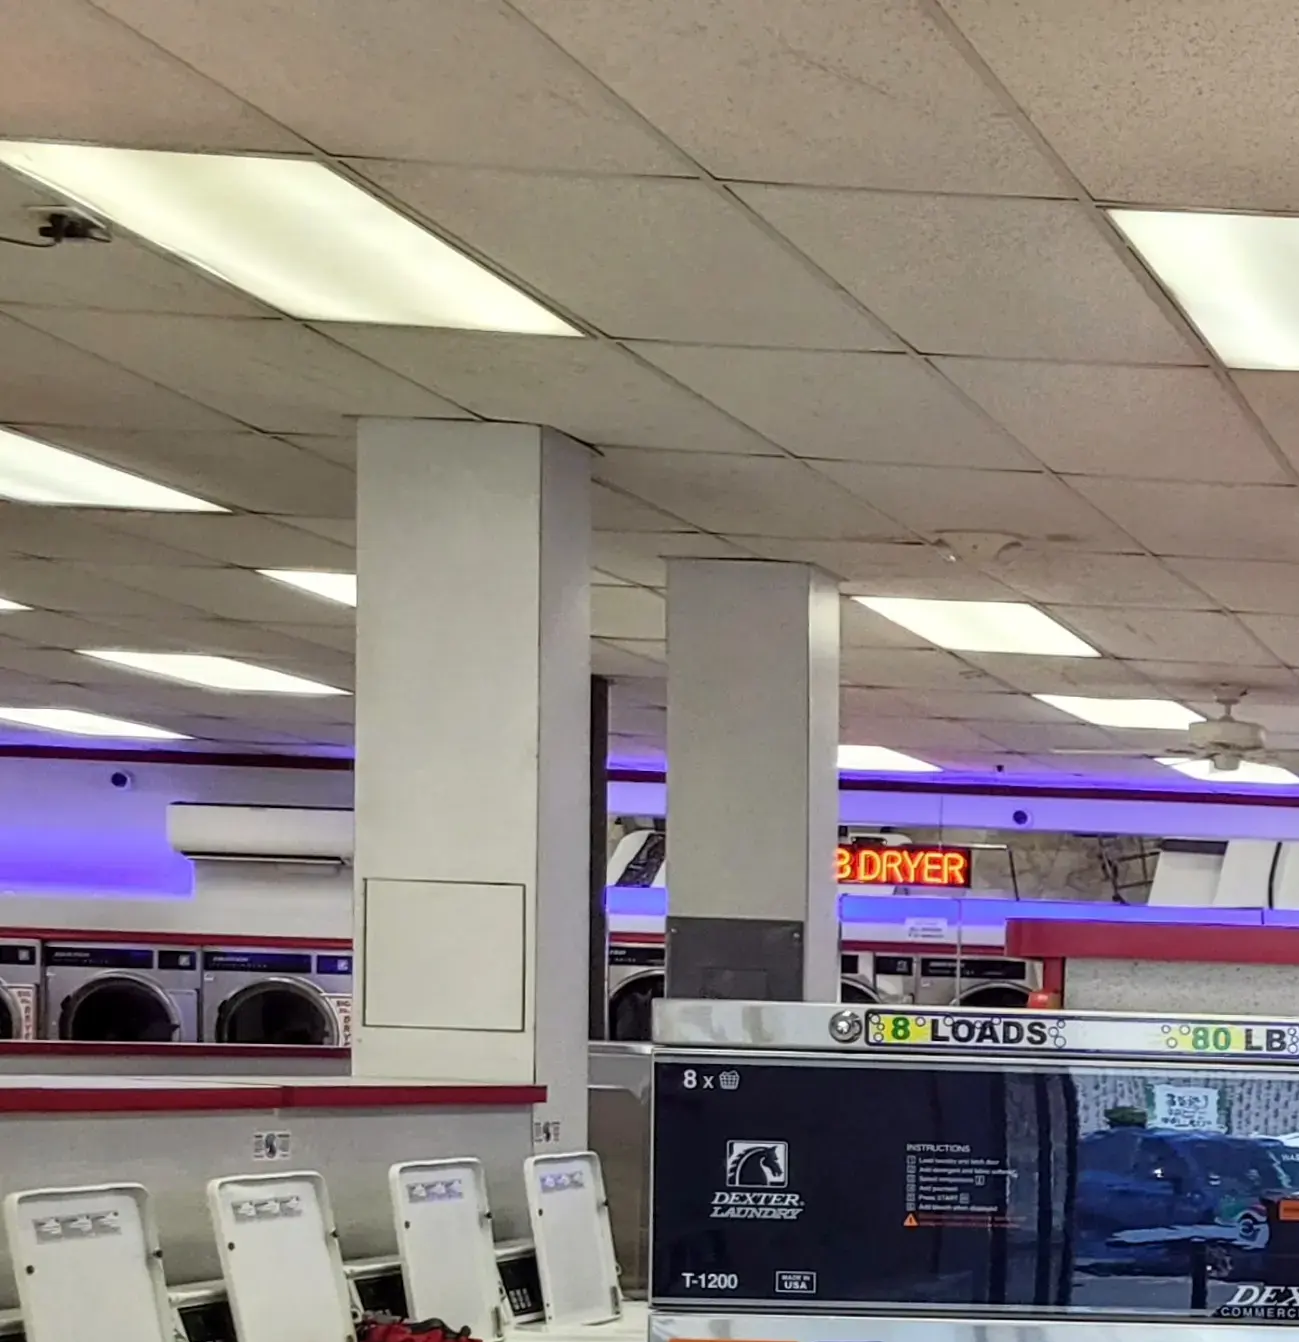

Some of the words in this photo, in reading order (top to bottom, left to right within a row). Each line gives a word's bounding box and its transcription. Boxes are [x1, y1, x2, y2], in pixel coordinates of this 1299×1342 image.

[858, 850, 967, 884] DRYER
[891, 1016, 910, 1041] 8
[930, 1019, 1048, 1046] LOADS
[1190, 1027, 1232, 1052] 80
[1245, 1028, 1288, 1053] LB
[683, 1069, 697, 1089] 8
[702, 1075, 714, 1089] x
[906, 1143, 971, 1153] INSTRUCTIONS
[711, 1191, 801, 1206] DEXTER
[709, 1206, 803, 1220] LAUNDRY
[681, 1272, 738, 1289] T-1200
[784, 1281, 808, 1290] USA
